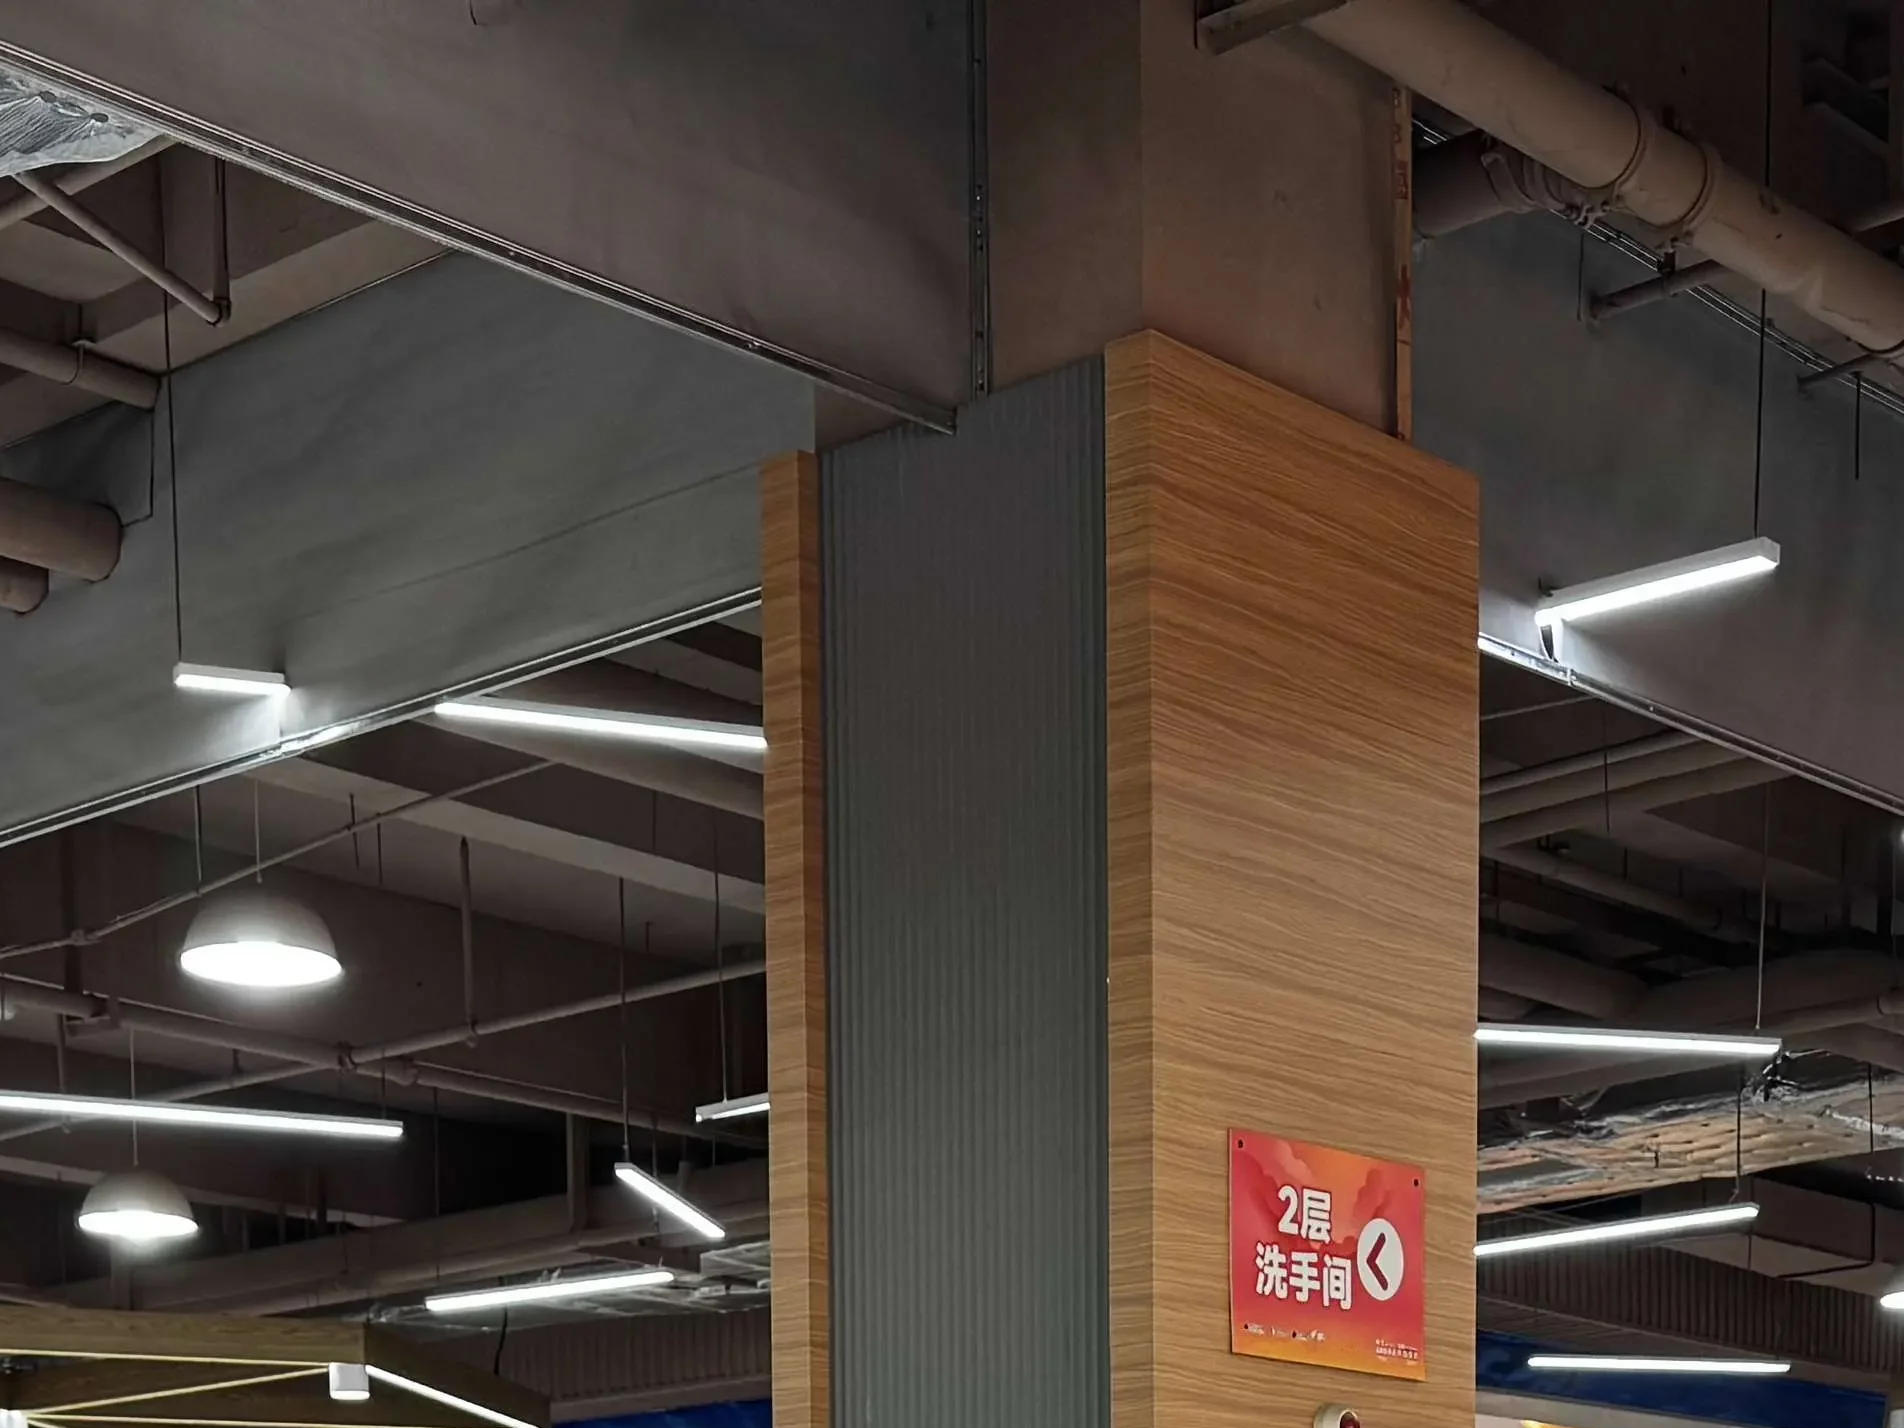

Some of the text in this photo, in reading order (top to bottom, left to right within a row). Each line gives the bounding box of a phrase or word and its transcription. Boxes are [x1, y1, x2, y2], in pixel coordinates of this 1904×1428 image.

[1277, 1185, 1332, 1244] 2层
[1255, 1241, 1352, 1310] 洗手间
